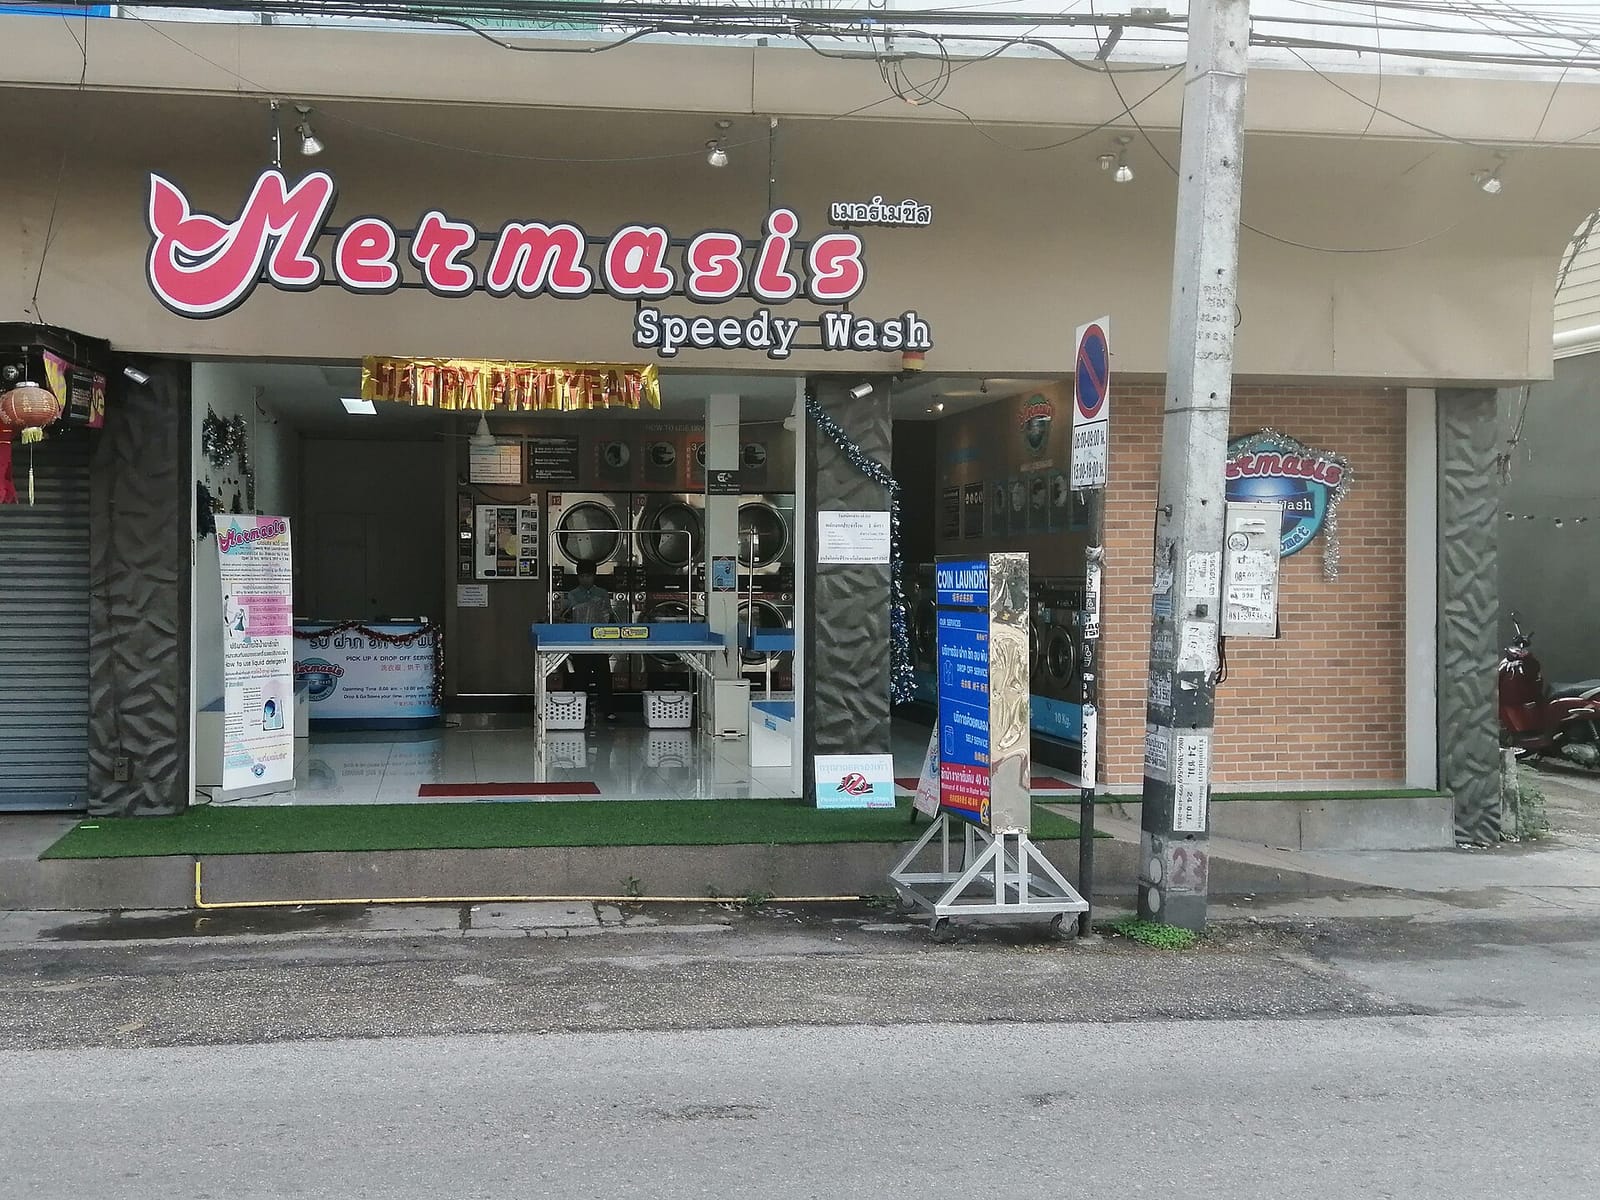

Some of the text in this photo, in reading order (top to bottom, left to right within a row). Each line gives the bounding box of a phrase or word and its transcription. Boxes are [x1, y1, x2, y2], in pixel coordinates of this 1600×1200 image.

[831, 195, 932, 225] เมอร์เมซิส
[148, 168, 864, 316] Mermasis
[636, 308, 931, 355] Speedy Wash
[937, 570, 989, 590] COIN LAUNDRY
